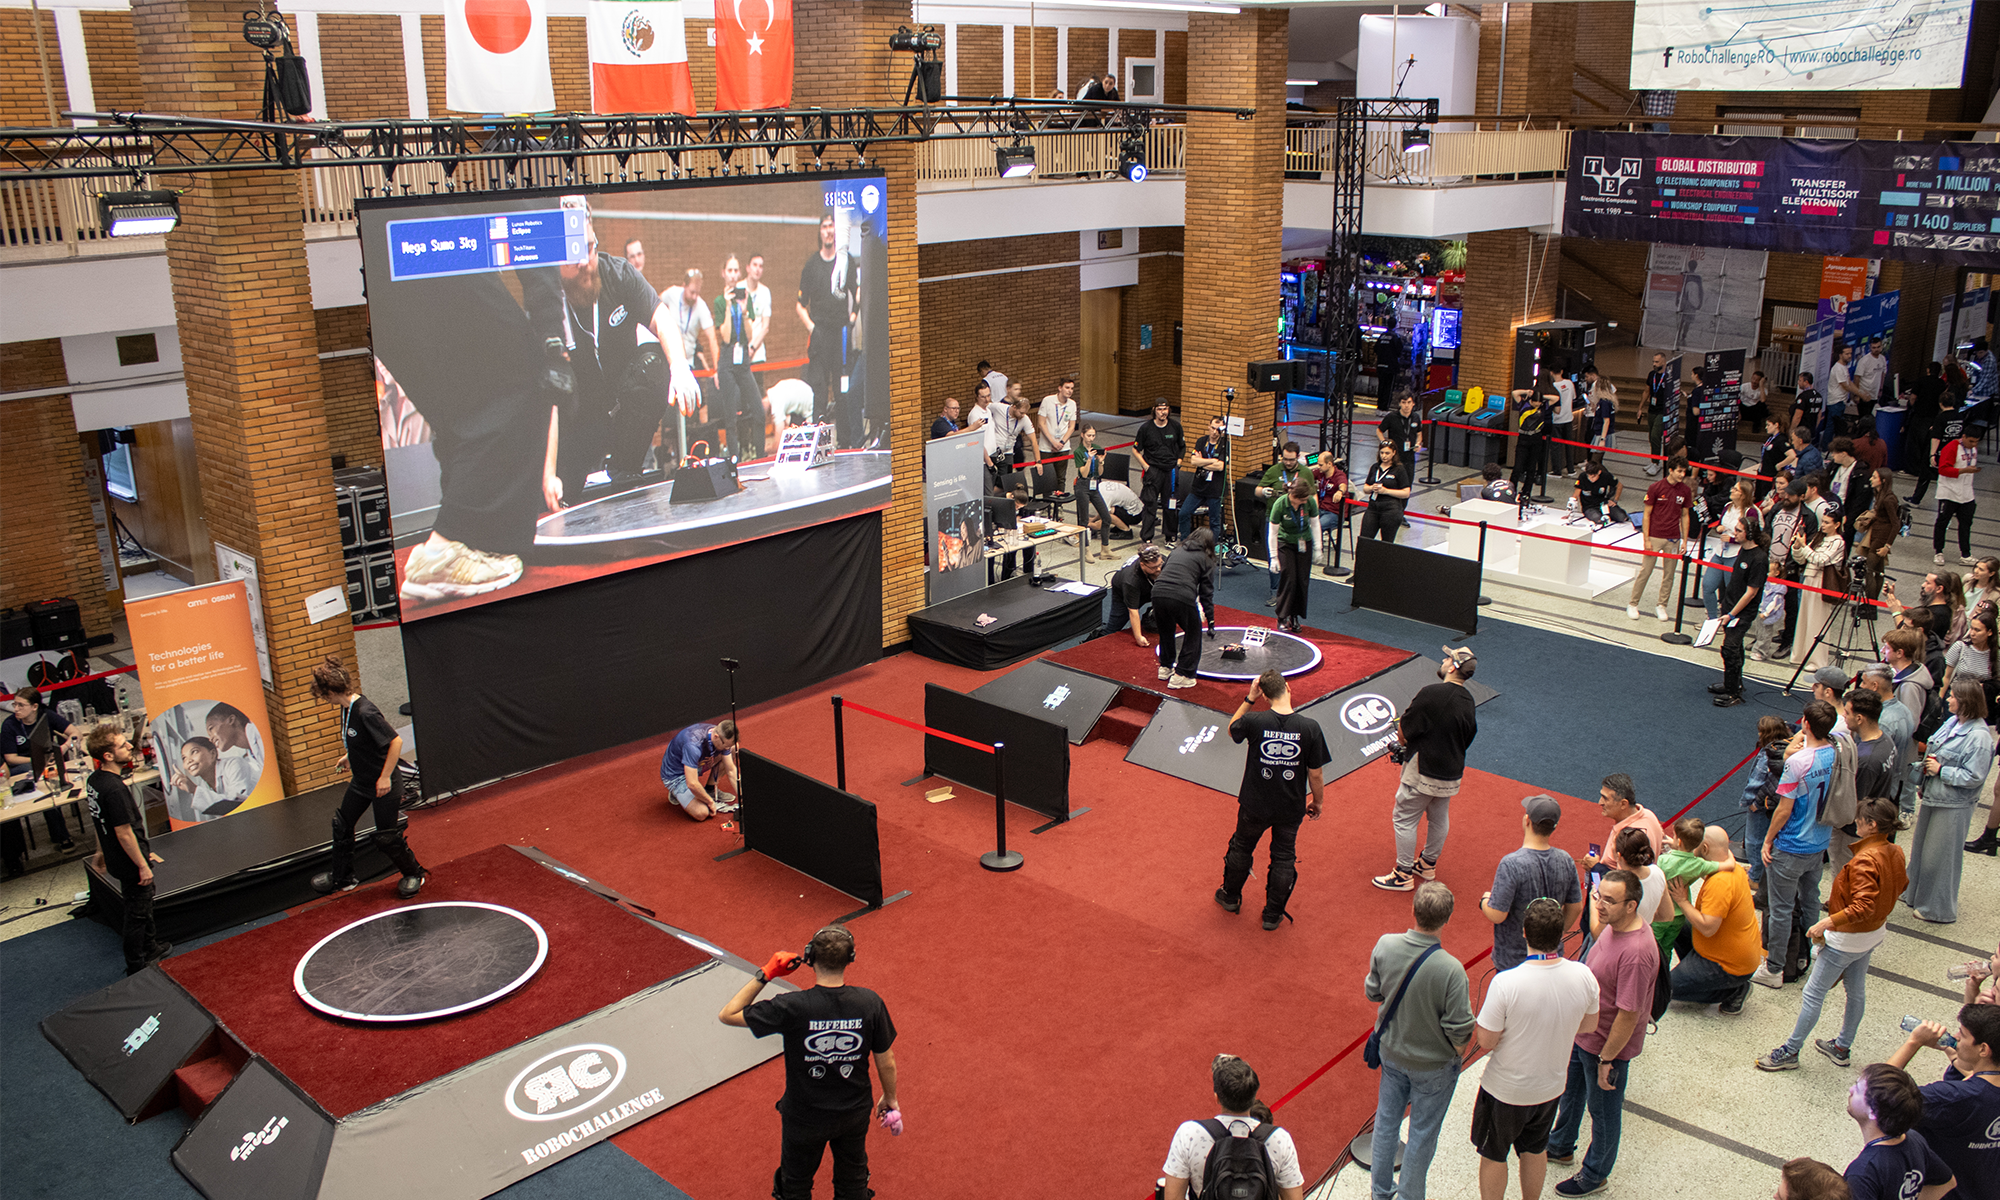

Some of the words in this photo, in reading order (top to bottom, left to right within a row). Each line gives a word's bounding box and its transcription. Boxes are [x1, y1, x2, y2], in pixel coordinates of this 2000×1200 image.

[1677, 49, 1776, 68] RoboChallengeRO
[1790, 48, 1922, 66] www.robochallenge.ro
[1662, 158, 1695, 173] GLOBAL
[1697, 160, 1757, 175] DISTRIBUTOR
[1656, 176, 1664, 184] OF
[1664, 177, 1699, 187] ELECTRONIC
[1700, 178, 1740, 188] COMPONENTS
[1790, 178, 1847, 189] TRANSFER
[1936, 174, 1942, 190] 1
[1944, 176, 1990, 192] MILLION
[1679, 188, 1712, 198] ELECTRICAL
[1714, 190, 1753, 200] ENGINEERING
[1799, 188, 1860, 199] MULTISORT
[1606, 196, 1638, 204] Components
[1670, 200, 1702, 211] WORKSHOP
[1703, 202, 1737, 212] EQUIPMENT
[1782, 196, 1848, 208] ELEKTRONIK
[570, 215, 579, 229] 0
[1921, 214, 1950, 230] 400
[1952, 222, 1986, 232] SUPPLIERS
[430, 238, 455, 252] Sumo
[459, 236, 478, 251] 3kg
[572, 242, 580, 255] 0
[933, 478, 953, 488] Sensing
[211, 593, 236, 603] OSRAM
[148, 643, 212, 661] Technologies
[151, 664, 166, 673] for
[177, 655, 207, 668] better
[209, 651, 224, 661] life
[809, 1018, 862, 1030] REFEREE
[520, 1087, 665, 1165] ROBOCHALLENGE
